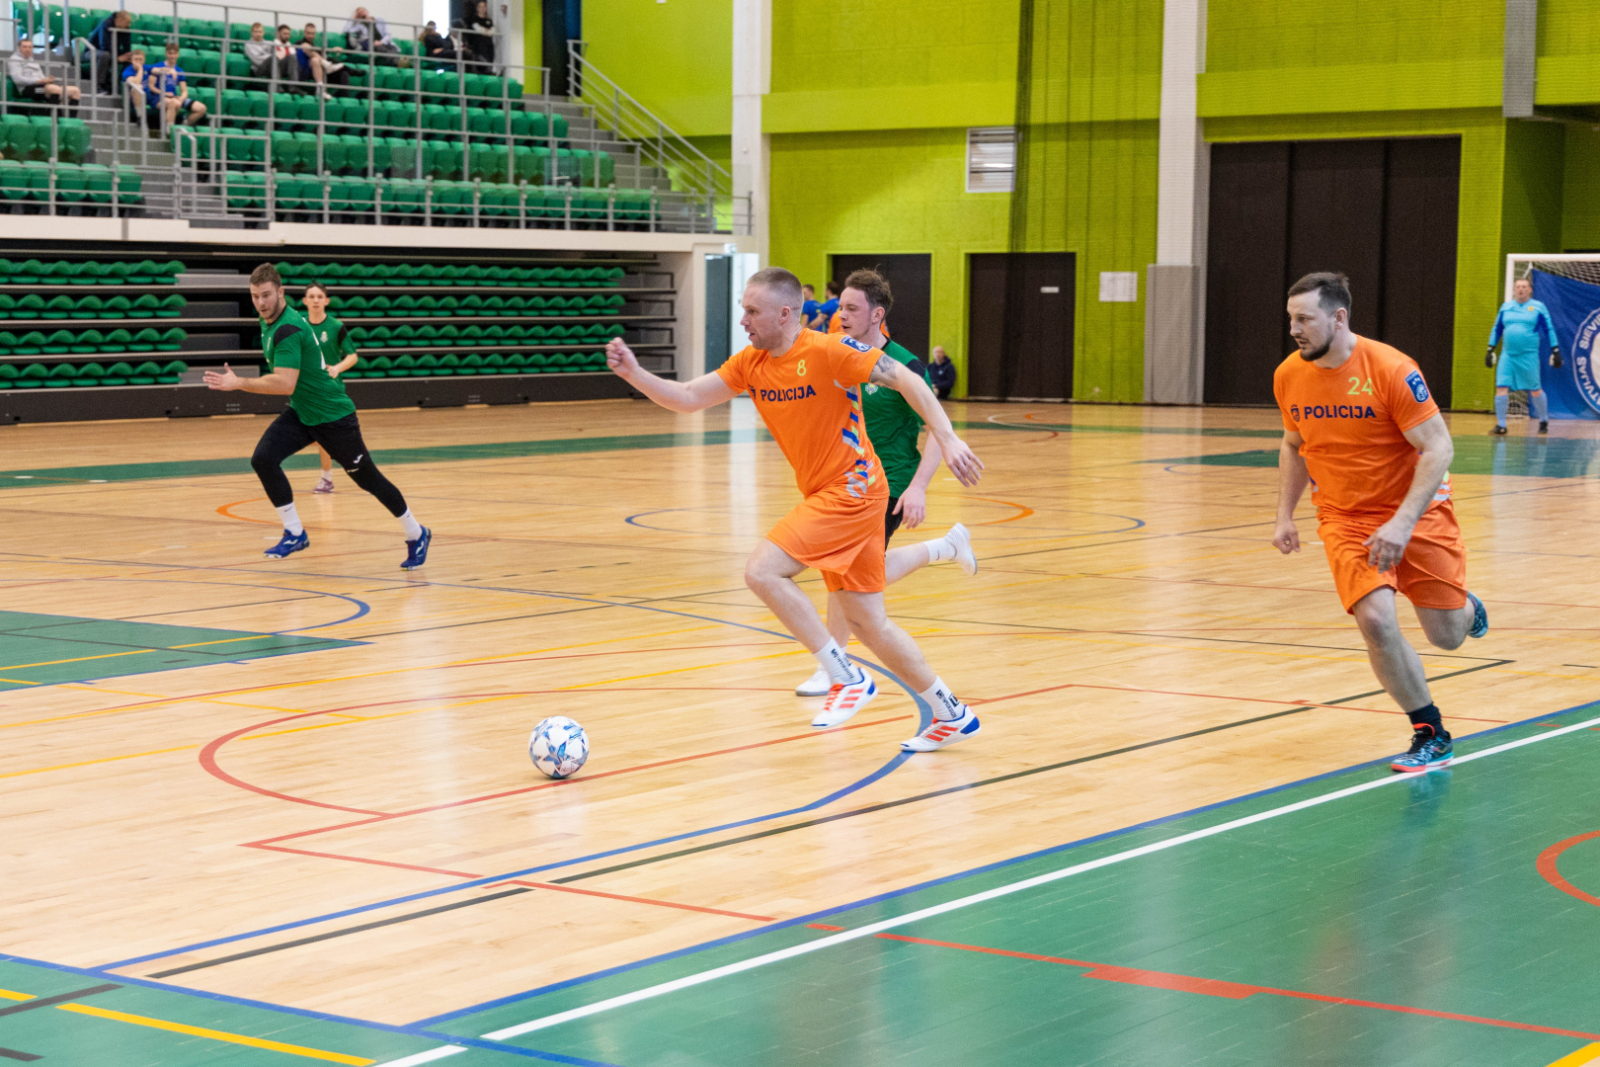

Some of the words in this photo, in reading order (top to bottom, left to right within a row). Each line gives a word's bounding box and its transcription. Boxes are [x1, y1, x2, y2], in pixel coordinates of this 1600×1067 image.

[796, 359, 807, 377] 8
[760, 384, 817, 402] POLICIJA
[1347, 376, 1373, 396] 24
[1303, 405, 1377, 420] POLICIJA
